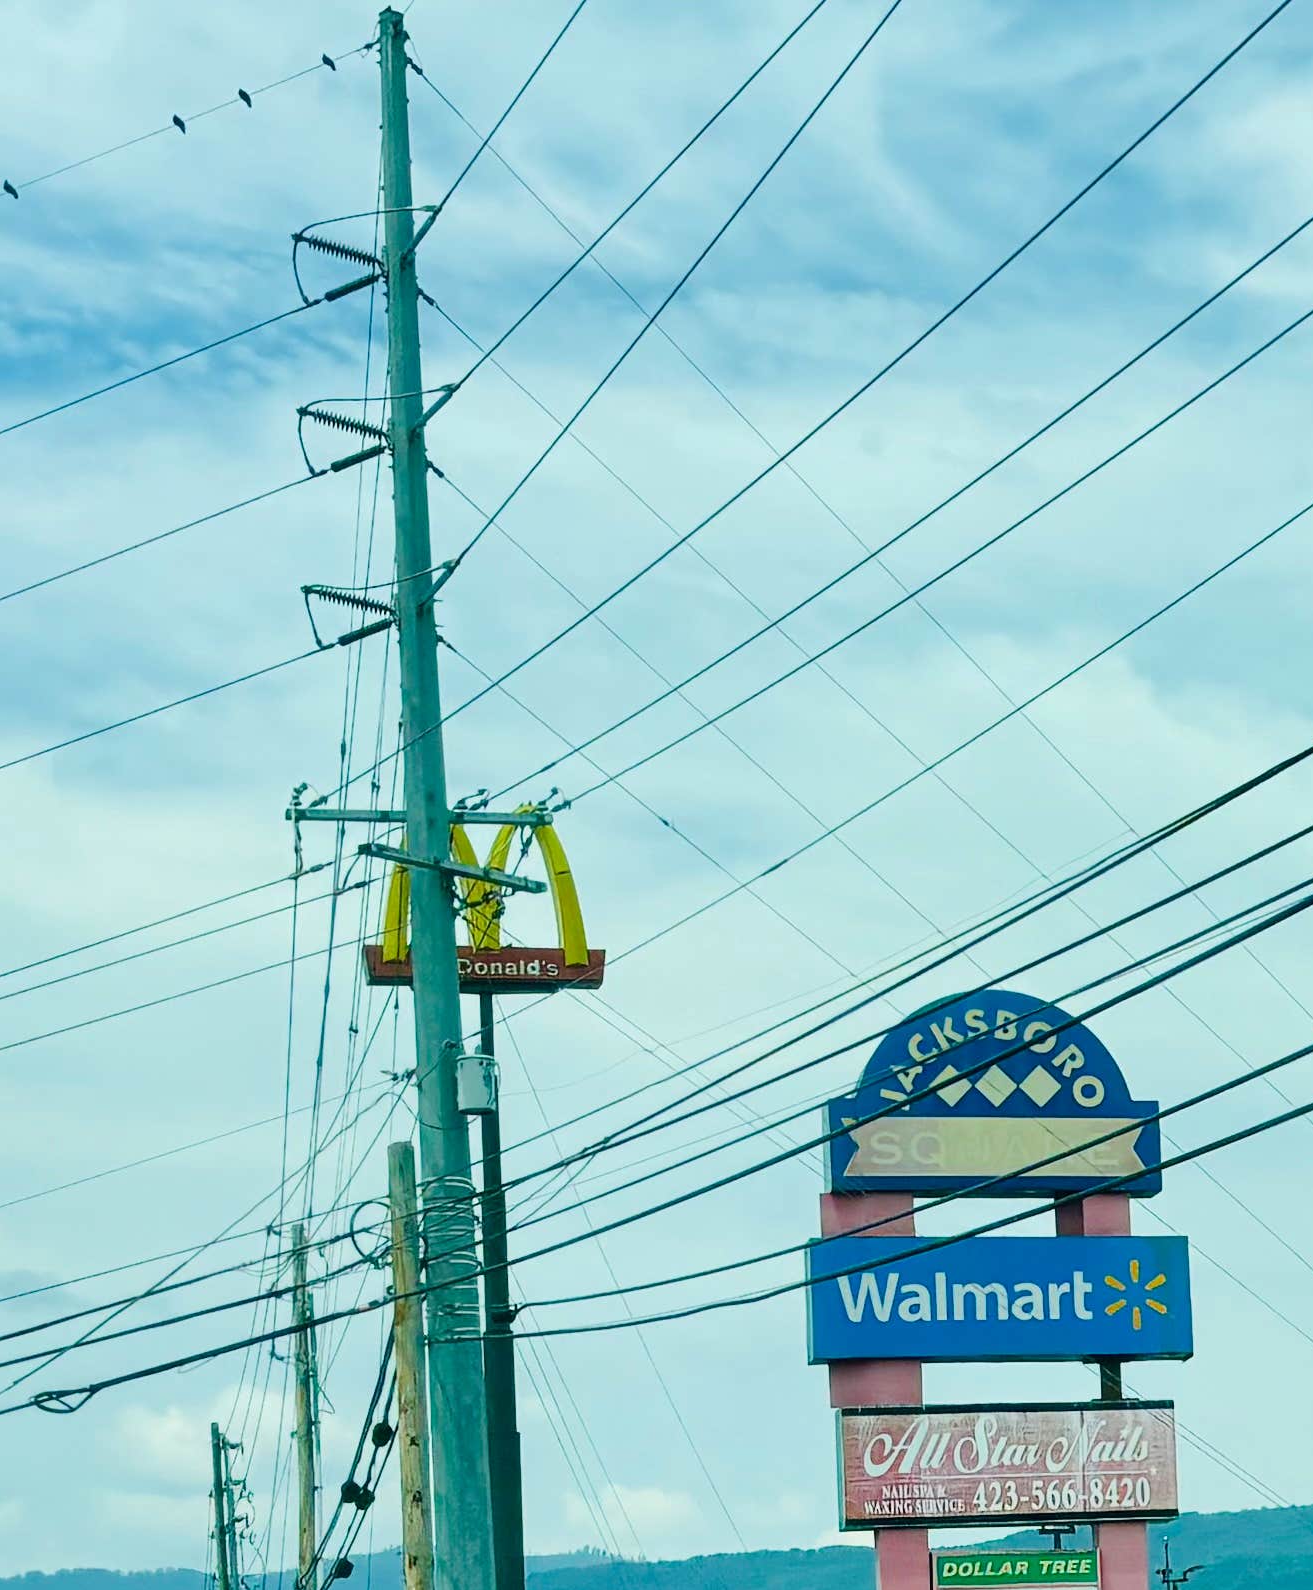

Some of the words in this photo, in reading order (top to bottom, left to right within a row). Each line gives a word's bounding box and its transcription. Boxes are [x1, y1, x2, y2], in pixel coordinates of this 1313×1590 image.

[458, 958, 559, 977] Donald's
[836, 1270, 1093, 1323] Walmart
[863, 1415, 951, 1478] All
[953, 1414, 1041, 1474] Star
[1045, 1418, 1150, 1473] Nails
[864, 1500, 913, 1515] WAXING
[973, 1476, 1151, 1512] 423-566-8420
[942, 1561, 1029, 1578] DOLLAR
[1039, 1559, 1093, 1575] TREE
